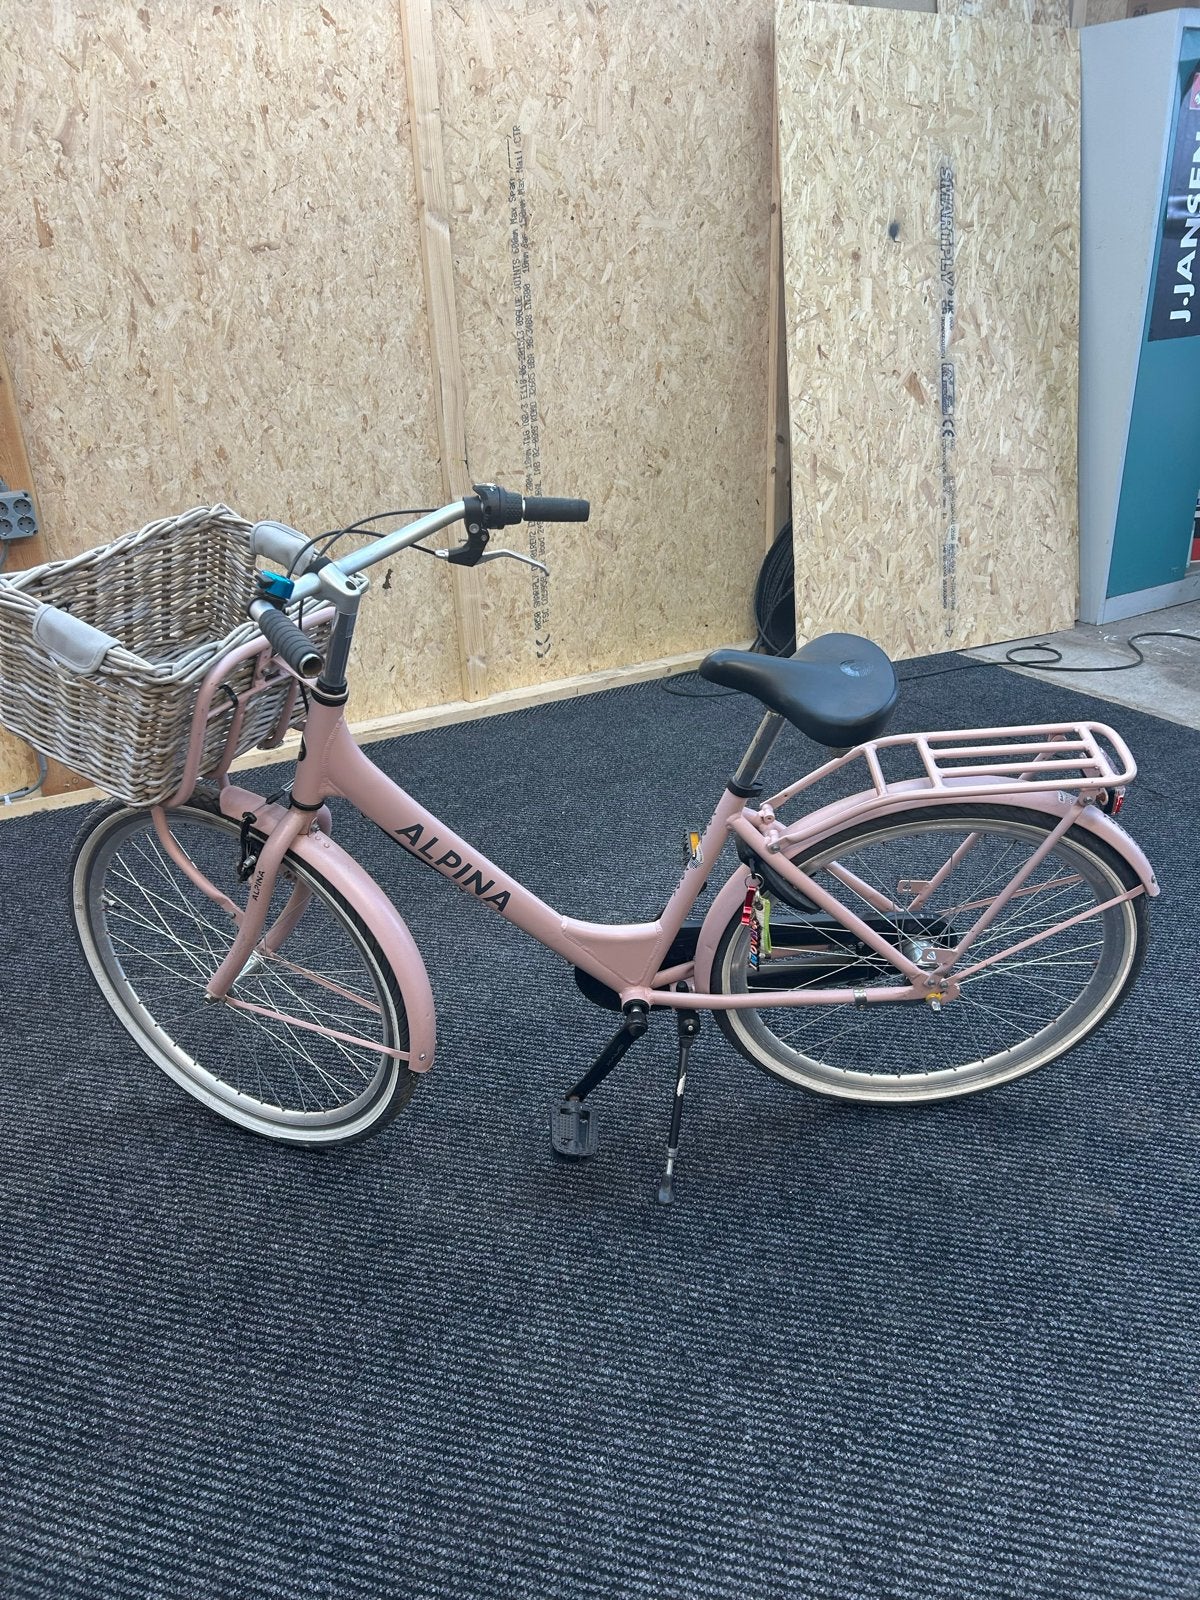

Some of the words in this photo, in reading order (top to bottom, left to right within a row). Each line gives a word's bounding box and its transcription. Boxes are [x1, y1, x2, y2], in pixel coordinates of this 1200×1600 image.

[512, 125, 522, 144] CTR
[508, 177, 517, 203] Span
[516, 177, 525, 196] Max
[510, 207, 518, 225] Max
[939, 167, 955, 287] SMARTPLY
[512, 258, 522, 291] JOINTS
[395, 823, 512, 913] ALPINA
[252, 870, 266, 902] ALPINA
